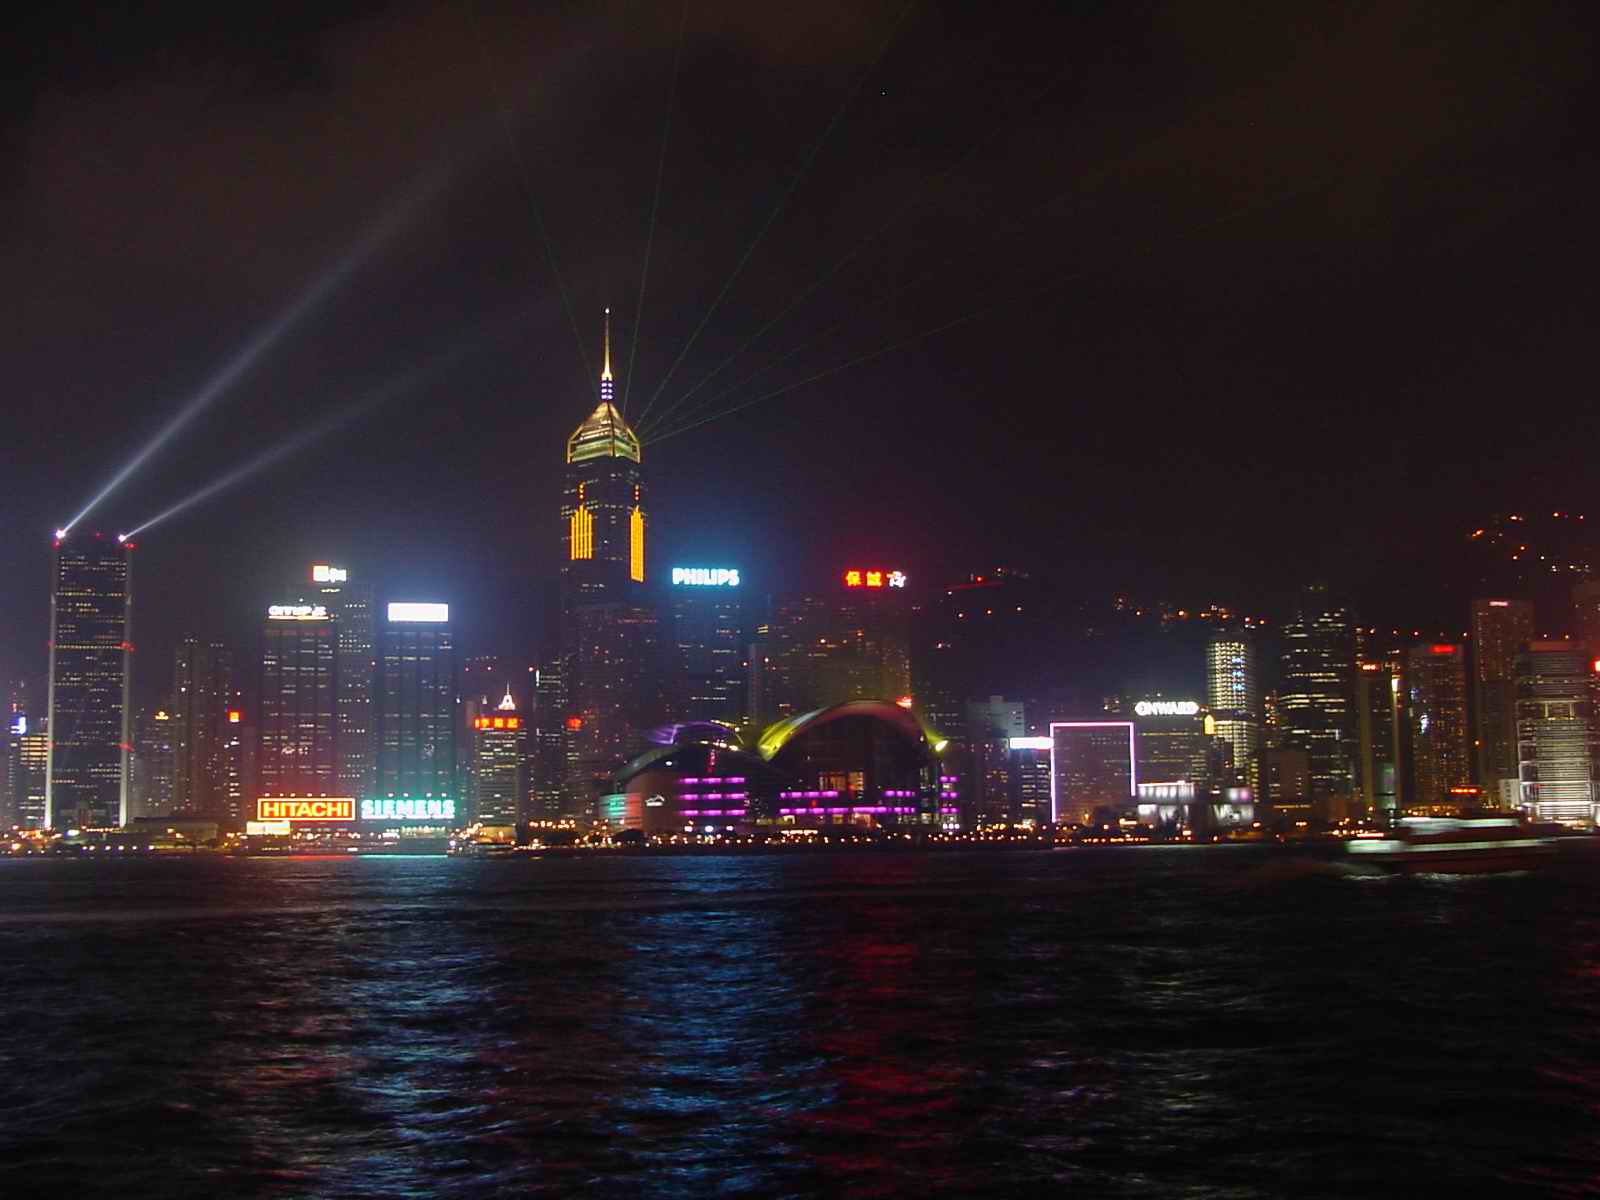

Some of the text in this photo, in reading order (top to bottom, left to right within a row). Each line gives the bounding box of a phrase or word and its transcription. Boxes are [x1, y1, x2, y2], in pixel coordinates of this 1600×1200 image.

[672, 567, 740, 586] PHILIPS
[263, 802, 349, 817] HITACHI
[361, 800, 455, 819] SIEMENS
